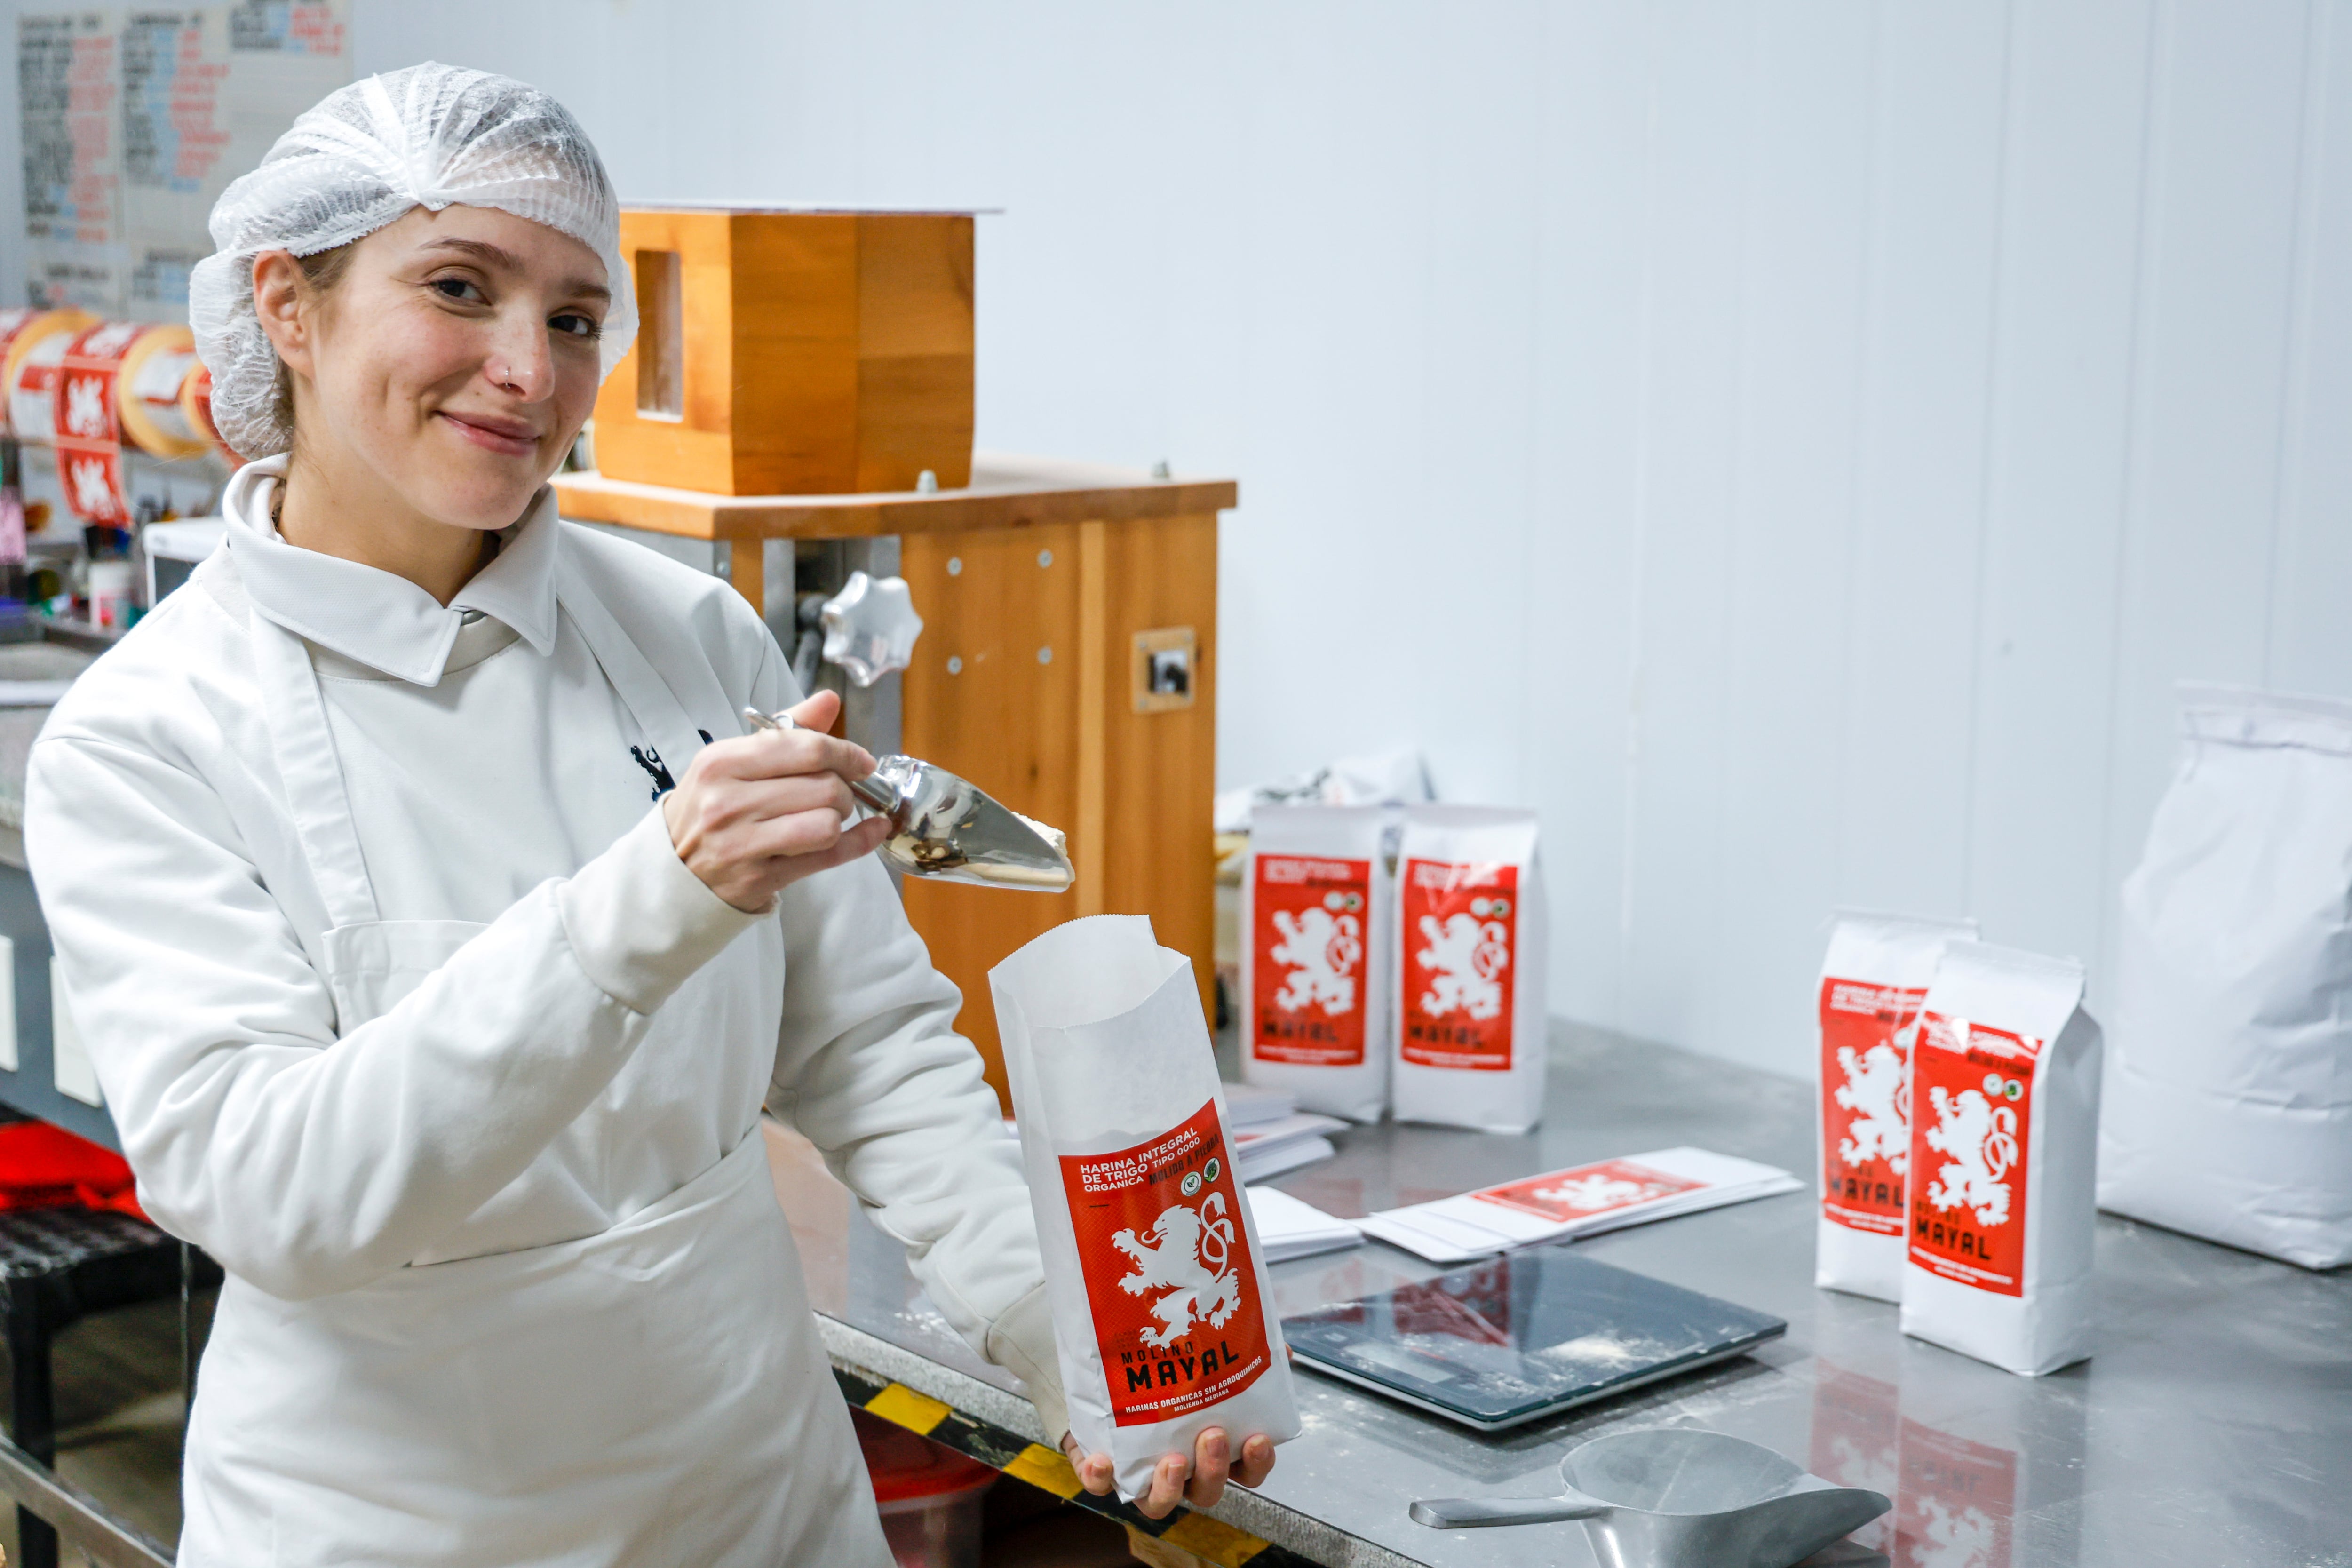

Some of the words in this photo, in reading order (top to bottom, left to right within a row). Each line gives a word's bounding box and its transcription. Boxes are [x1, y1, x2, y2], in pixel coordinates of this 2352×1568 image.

[1080, 1158, 1136, 1174] HARINA
[1138, 1127, 1197, 1163] INTEGRAL
[1082, 1173, 1102, 1184] DE
[1104, 1163, 1148, 1182] TRIGO
[1152, 1152, 1175, 1168] TIPO
[1084, 1175, 1144, 1192] ORGANICA
[1149, 1159, 1184, 1186] MOLIDO
[1187, 1154, 1193, 1167] A
[1194, 1133, 1219, 1162] PIEDRA
[1121, 1341, 1194, 1364] MOLINO
[1126, 1340, 1240, 1393] MAYAL
[1125, 1401, 1159, 1413] HARINAS
[1160, 1390, 1203, 1408] ORGANICAS
[1204, 1385, 1216, 1395] SIN
[1218, 1355, 1262, 1389] AGROQUIMICOS
[1174, 1399, 1204, 1412] MOLIENDA
[1204, 1388, 1229, 1402] MEDIANA
